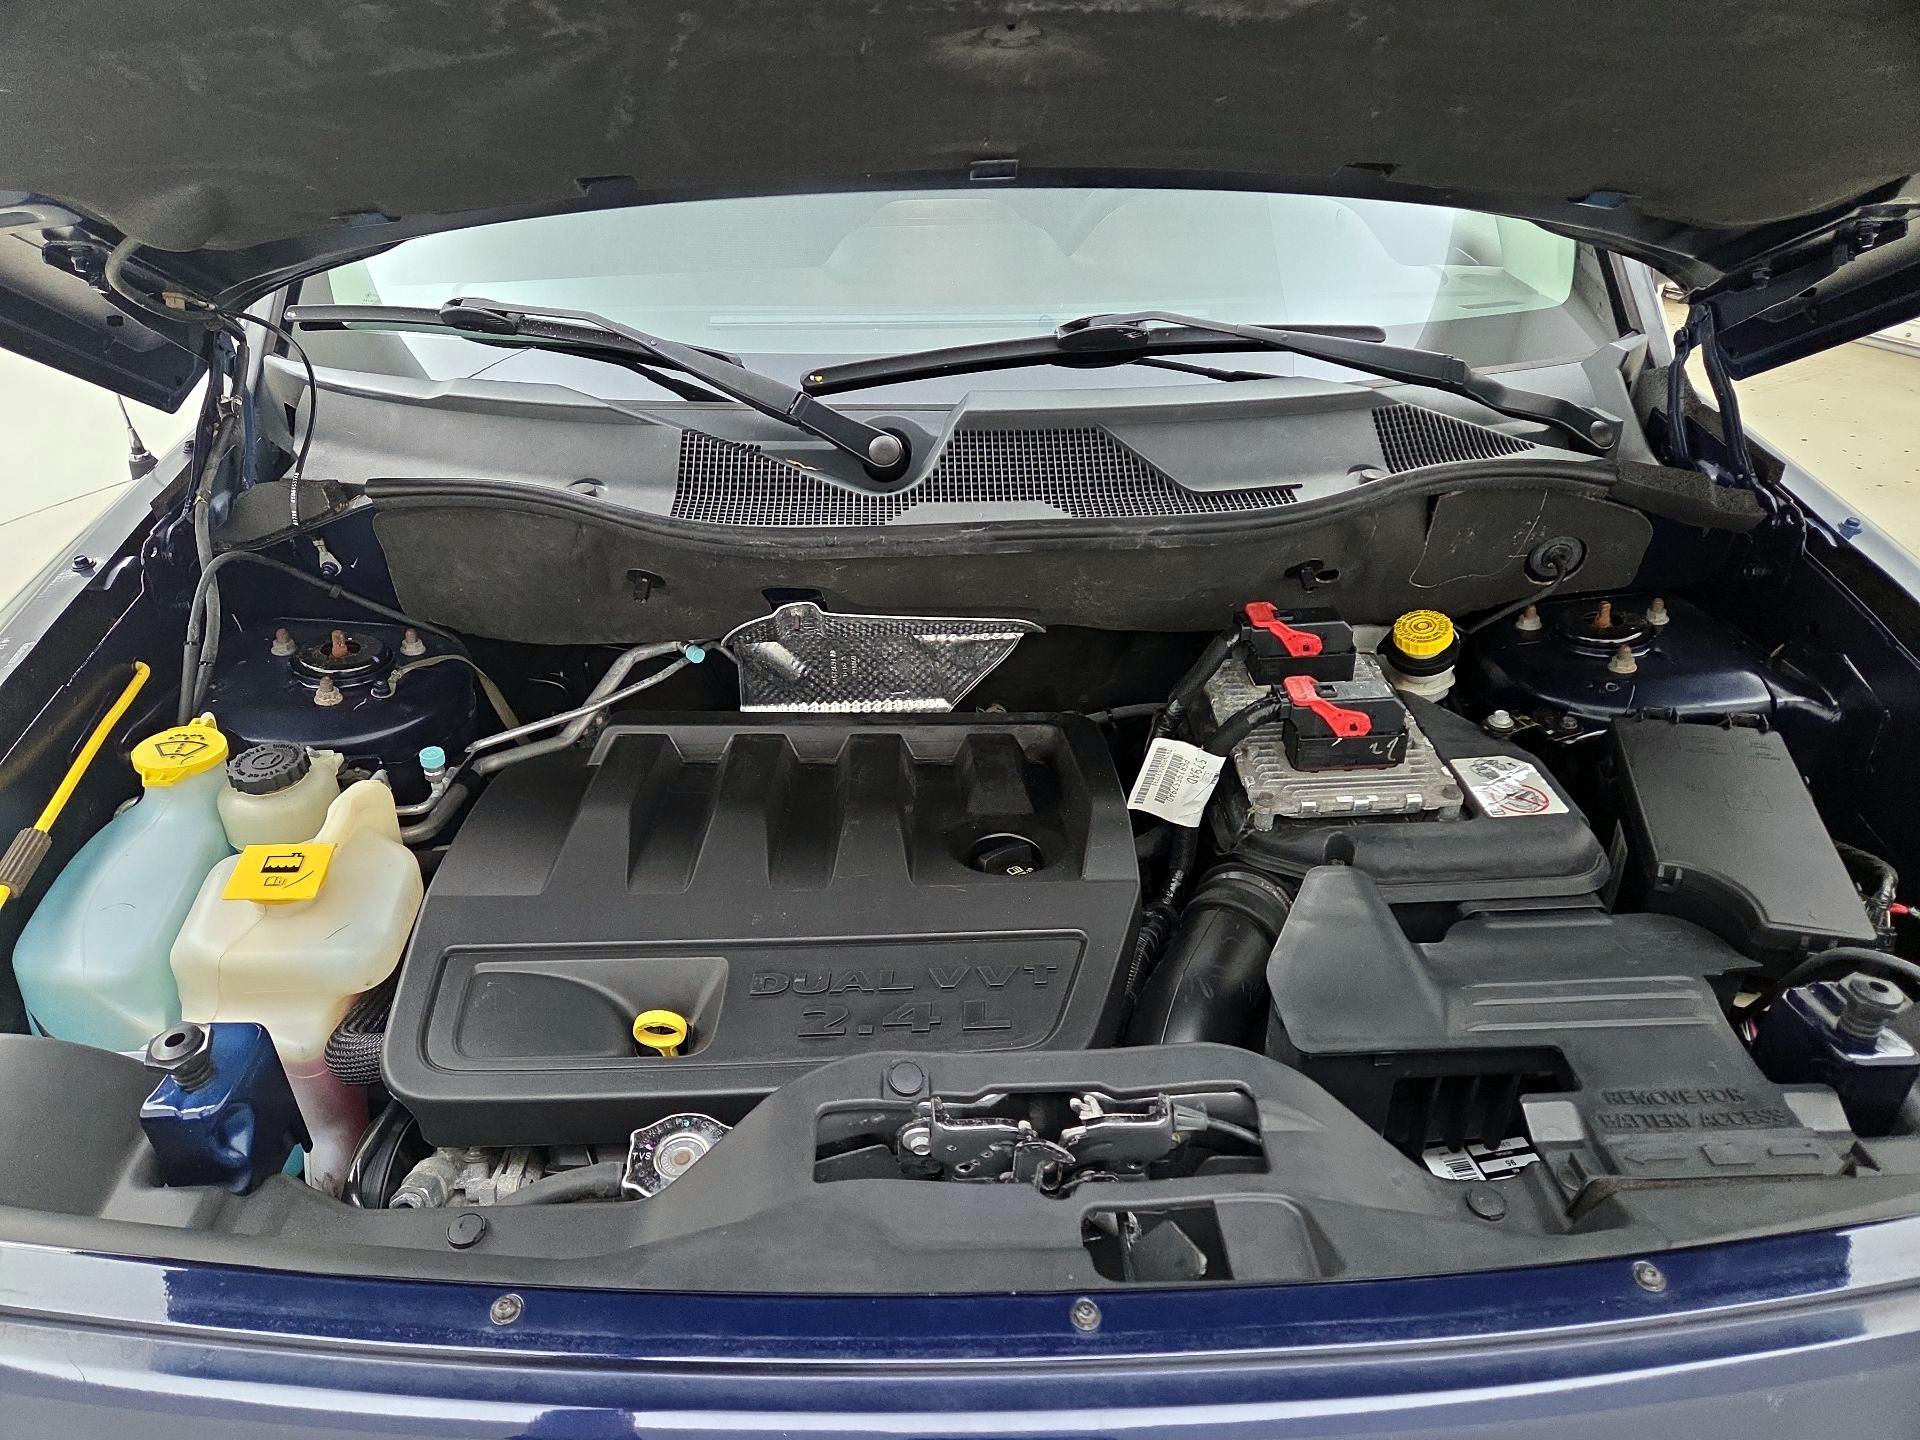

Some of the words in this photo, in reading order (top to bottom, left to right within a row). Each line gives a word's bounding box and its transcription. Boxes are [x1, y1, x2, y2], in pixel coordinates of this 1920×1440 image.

[749, 969, 914, 996] DUAL
[929, 963, 1058, 990] VVT
[1602, 1088, 1698, 1106] REMOVE
[1696, 1087, 1746, 1103] FOR
[1597, 1111, 1691, 1129] BATTERY
[1700, 1108, 1786, 1128] ACCESS
[632, 1151, 652, 1161] TVS
